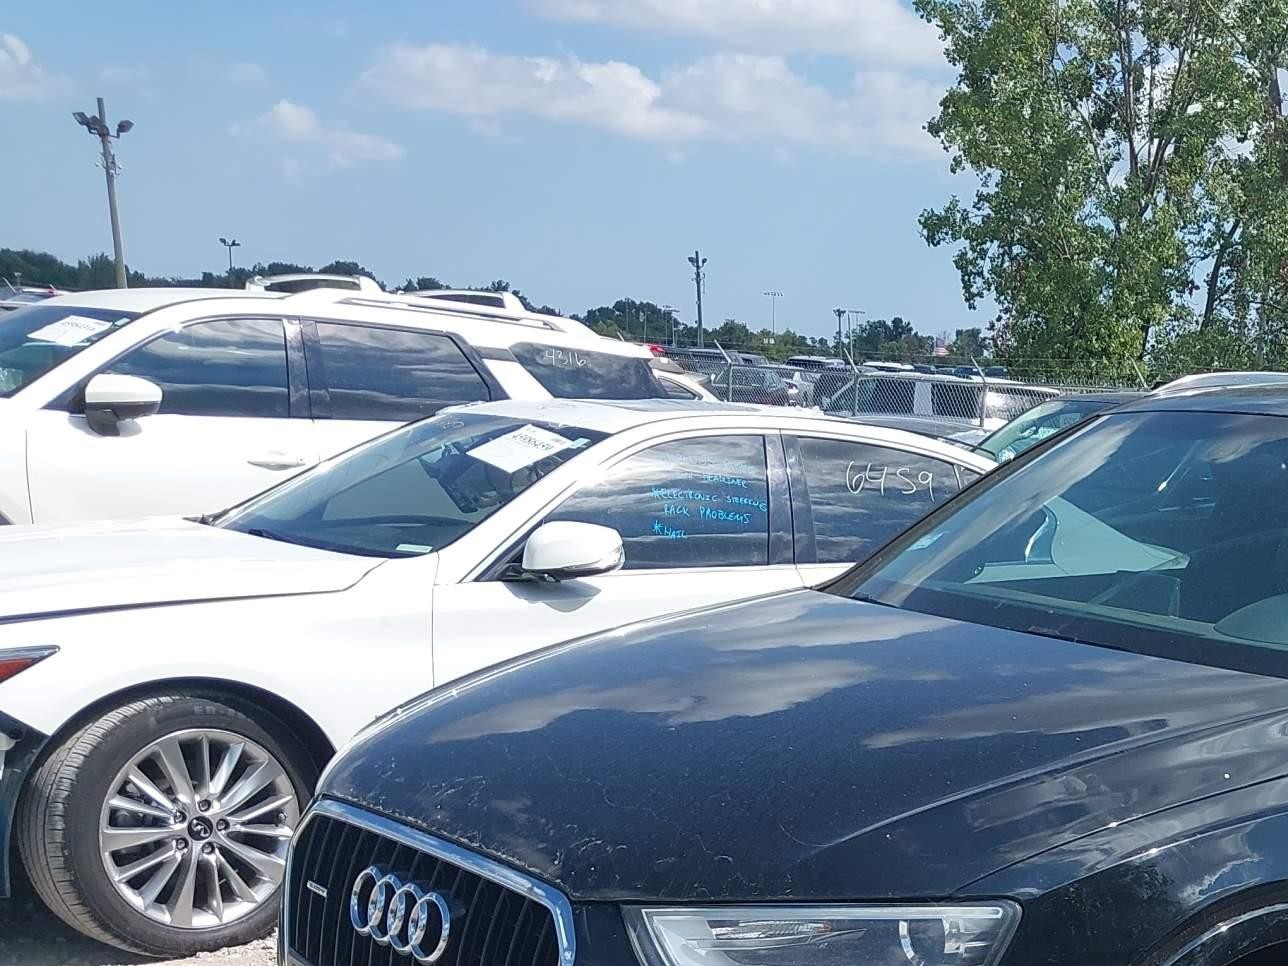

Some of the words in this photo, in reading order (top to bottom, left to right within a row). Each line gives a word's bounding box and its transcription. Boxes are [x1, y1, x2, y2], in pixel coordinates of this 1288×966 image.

[545, 348, 587, 367] 4316
[846, 460, 935, 503] 6459
[700, 506, 752, 524] PROBLEMS
